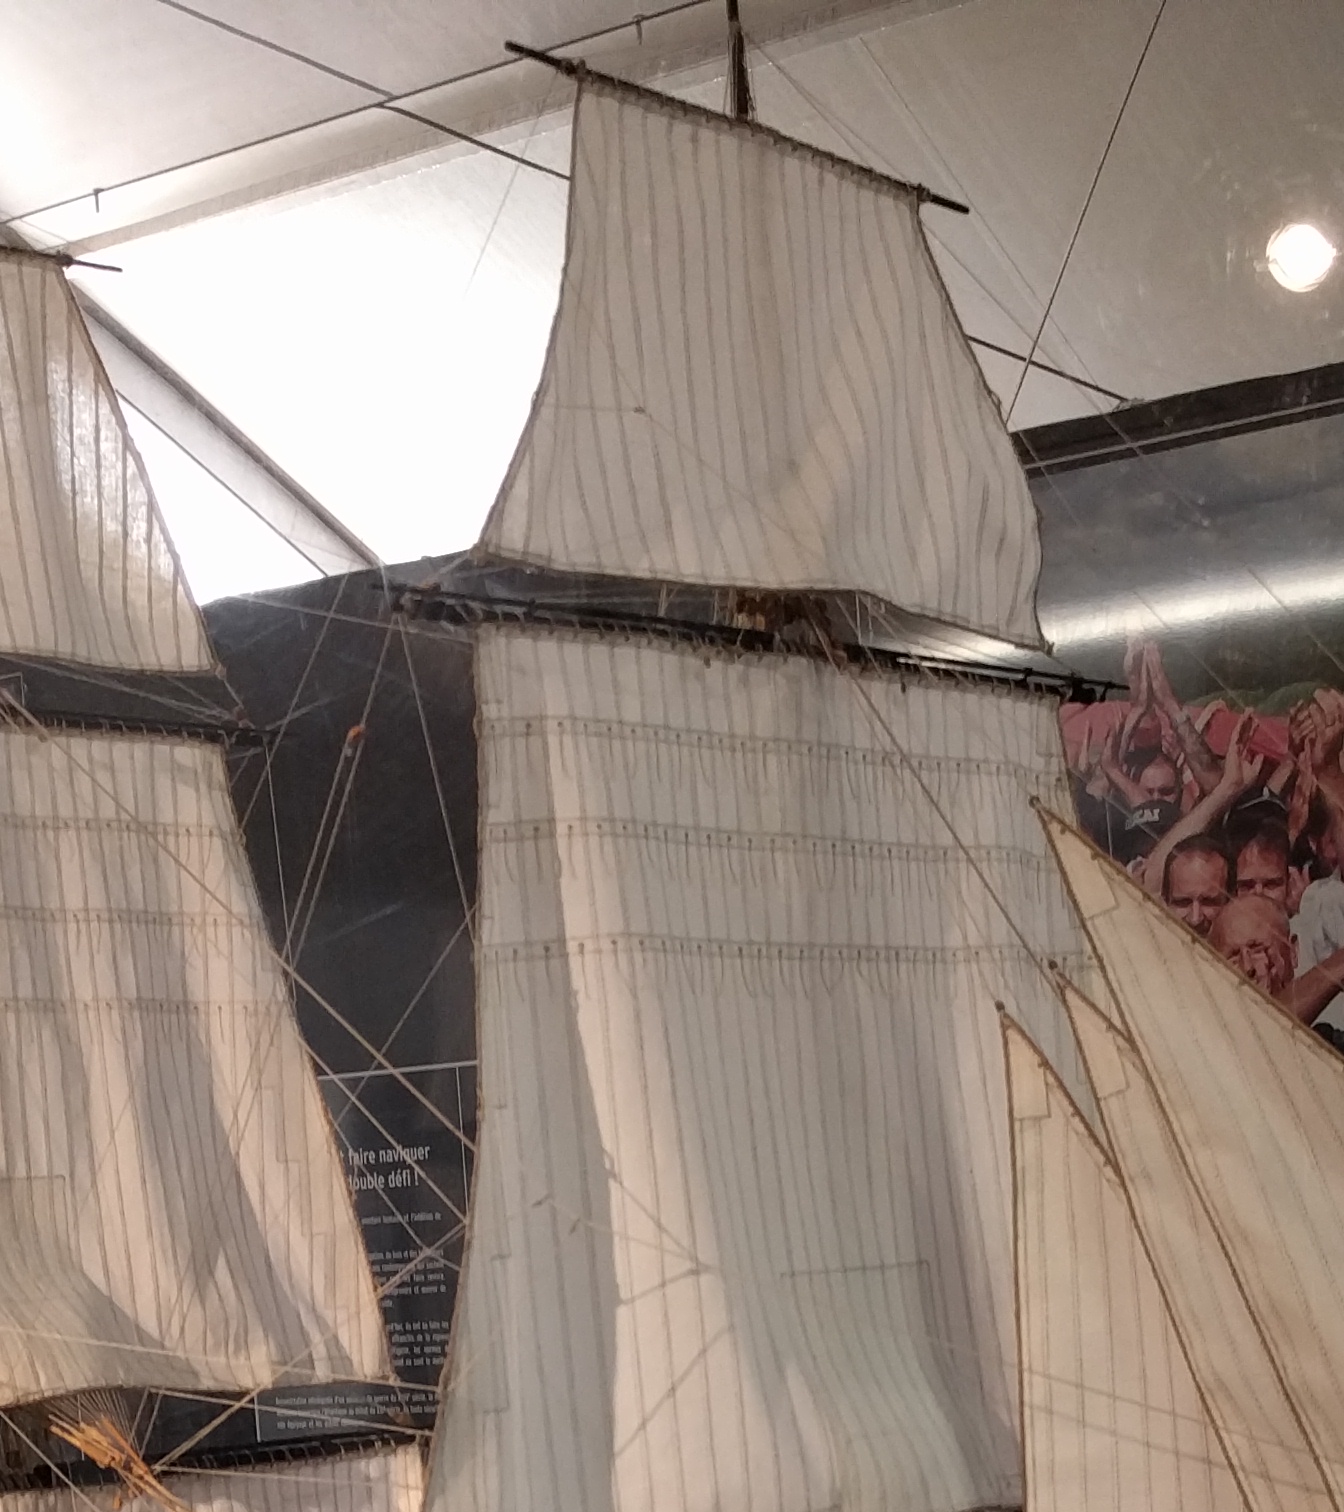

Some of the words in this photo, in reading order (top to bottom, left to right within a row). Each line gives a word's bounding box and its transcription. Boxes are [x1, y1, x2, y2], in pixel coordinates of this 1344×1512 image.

[348, 1147, 376, 1166] faire
[379, 1143, 430, 1165] naviguer
[388, 1168, 411, 1188] défi
